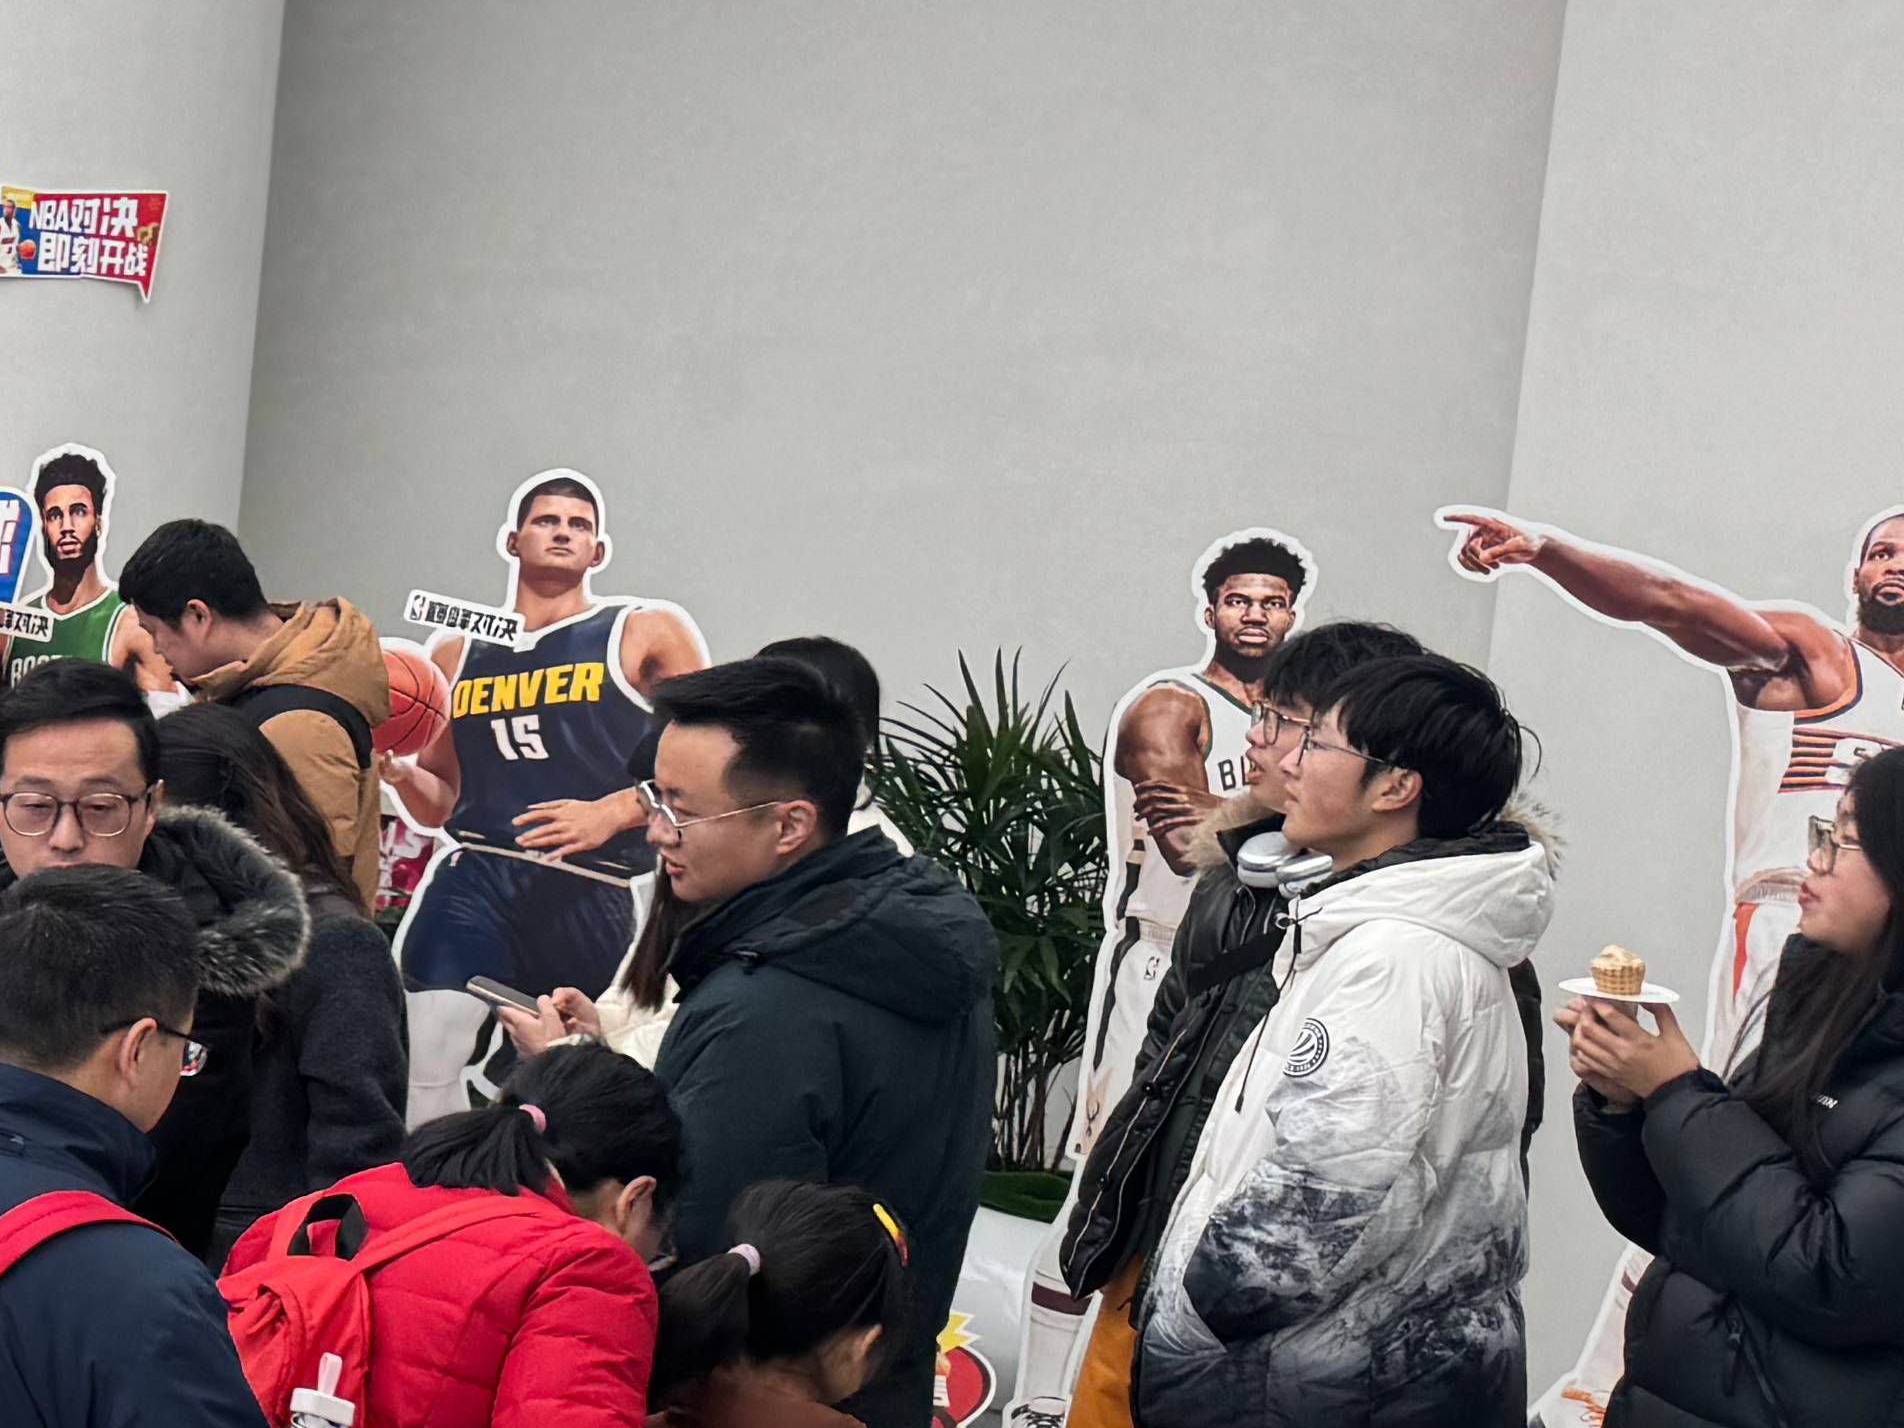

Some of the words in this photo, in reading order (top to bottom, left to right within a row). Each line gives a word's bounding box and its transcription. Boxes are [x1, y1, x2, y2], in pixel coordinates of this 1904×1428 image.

[29, 197, 138, 237] NBA对决
[37, 232, 149, 276] 即刻开战
[452, 662, 605, 718] DENVER
[490, 715, 550, 762] 15
